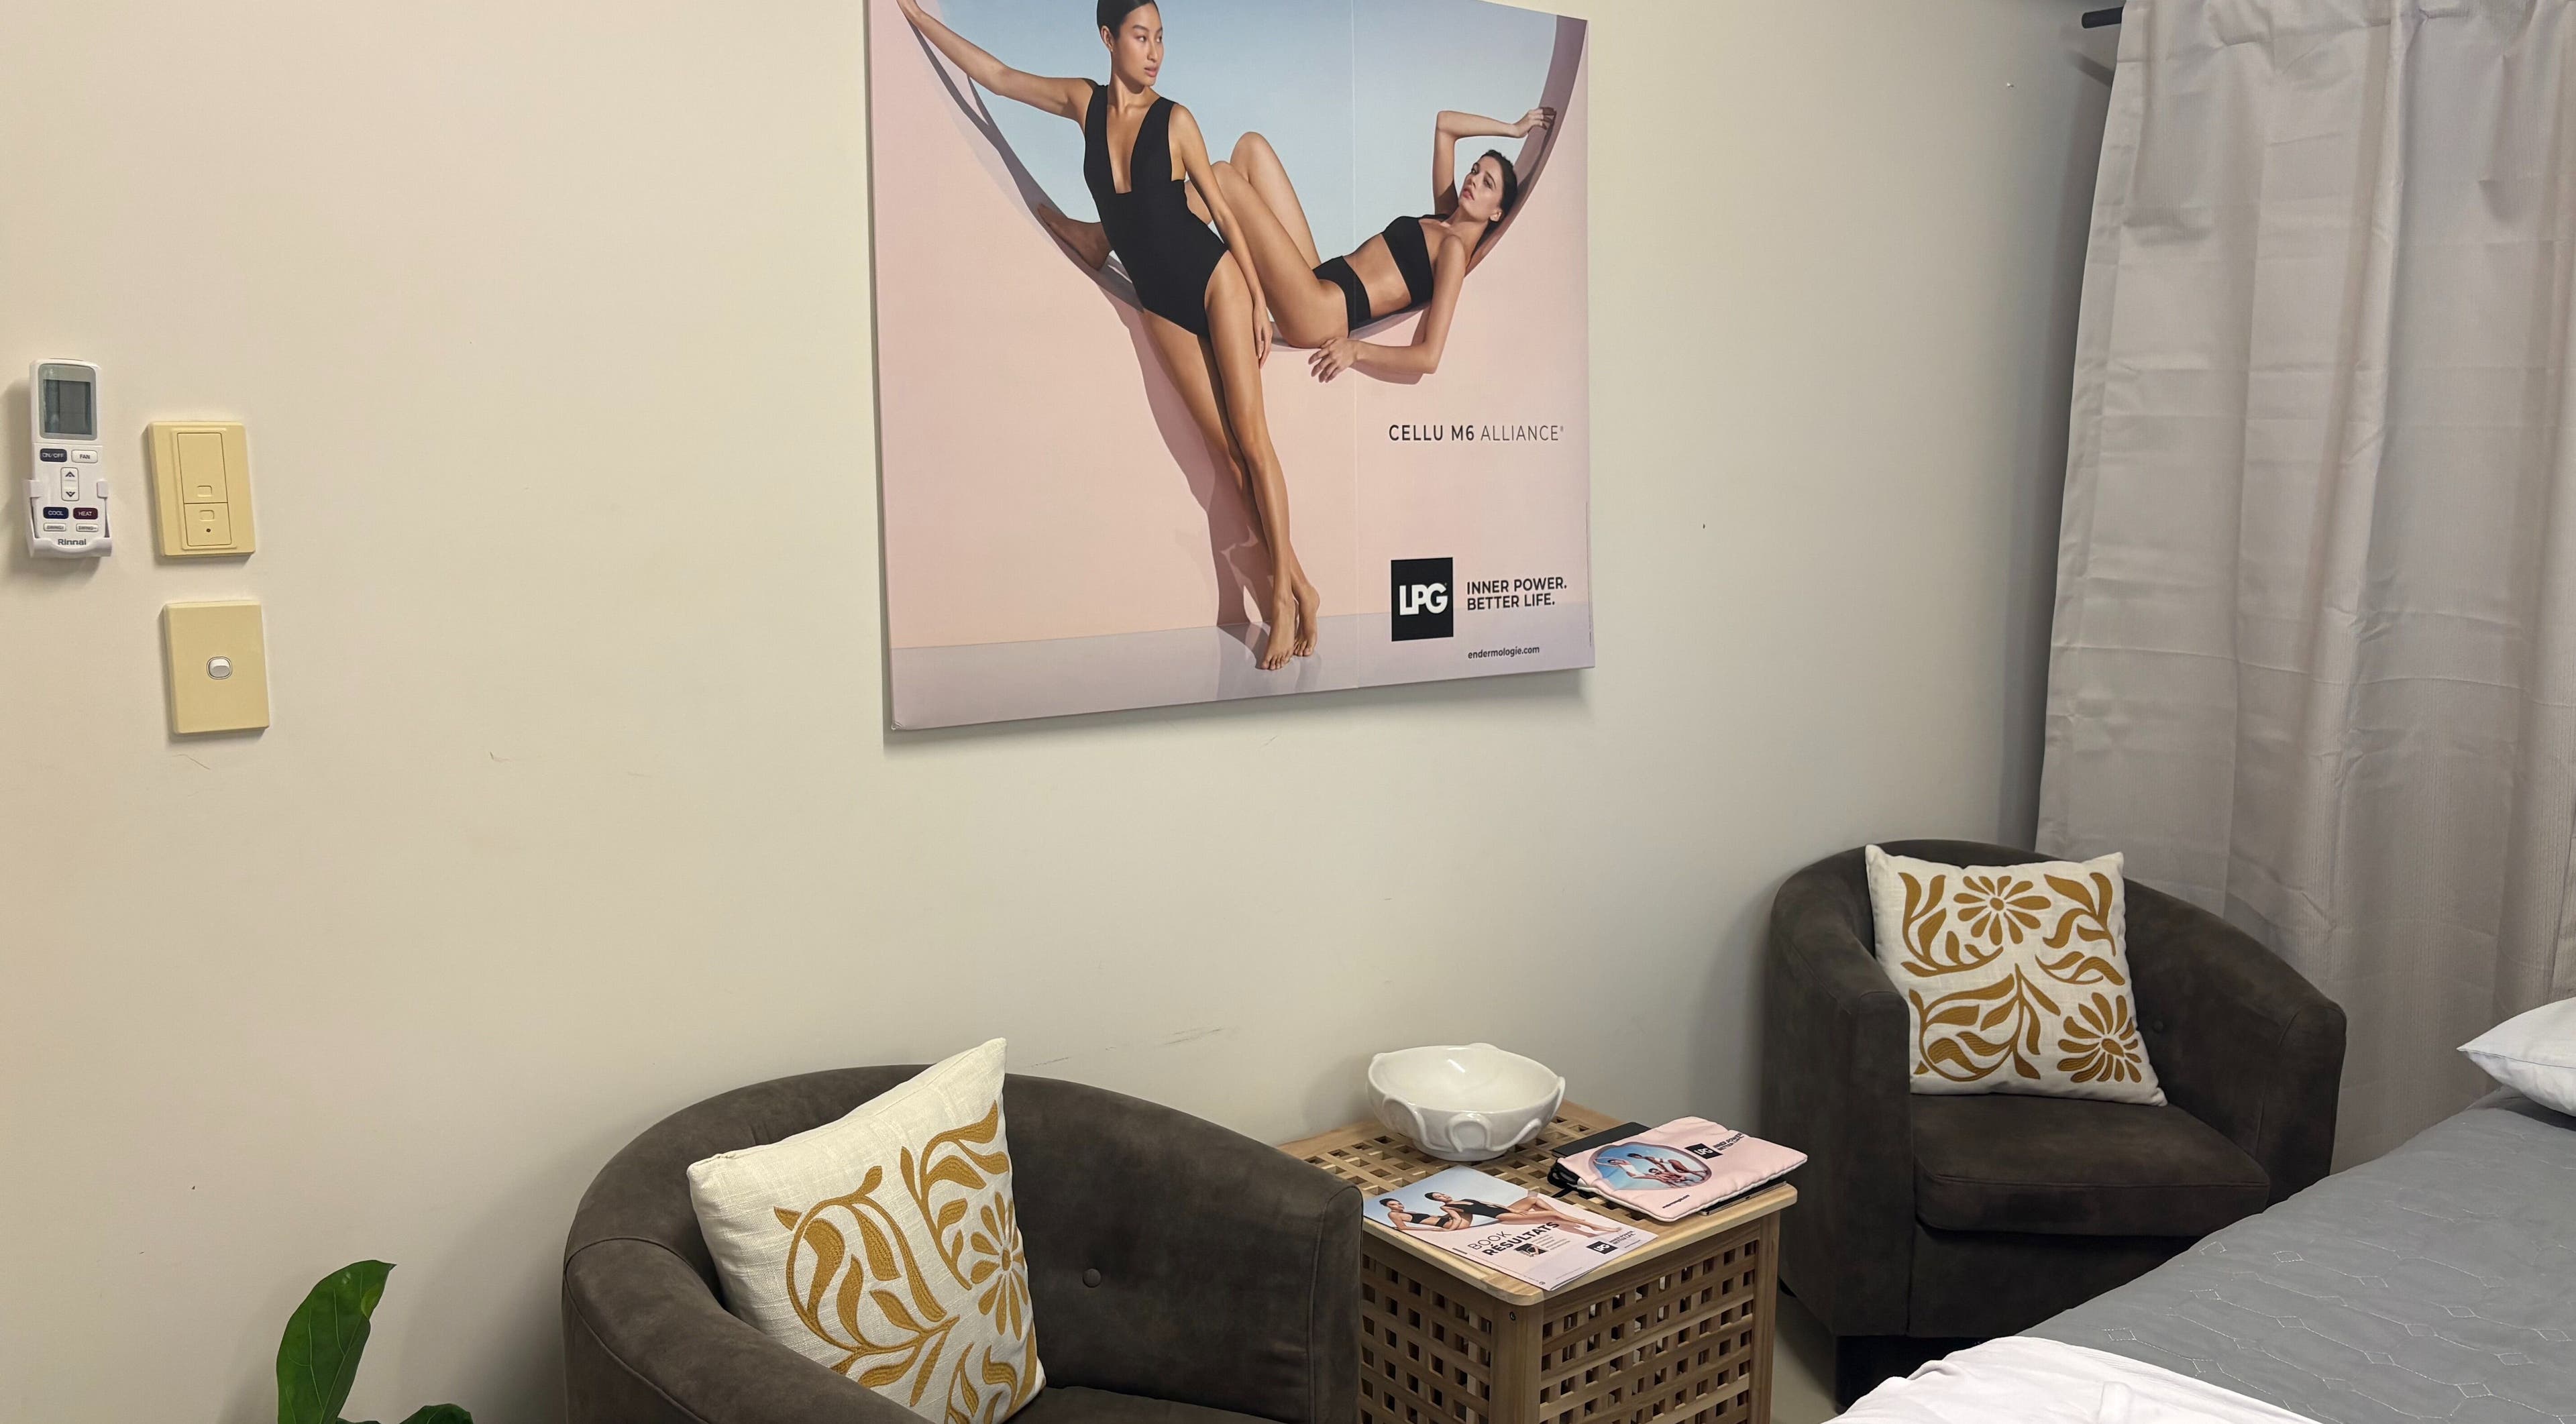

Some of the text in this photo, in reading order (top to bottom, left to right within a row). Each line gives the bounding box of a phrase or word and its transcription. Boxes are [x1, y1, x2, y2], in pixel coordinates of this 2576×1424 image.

[1389, 425, 1444, 441] CELLU
[1451, 425, 1474, 441] M6
[57, 538, 87, 546] Rinnai
[1466, 576, 1568, 595] INNER POWER.
[1399, 582, 1448, 616] LPG
[1466, 592, 1556, 611] BETTER LIFE.
[1468, 645, 1540, 659] endermologie.com
[1693, 1147, 1713, 1156] LPG
[1467, 1231, 1512, 1250] BOOK
[1482, 1221, 1560, 1256] RÉSULTATS
[1593, 1244, 1611, 1252] LPG
